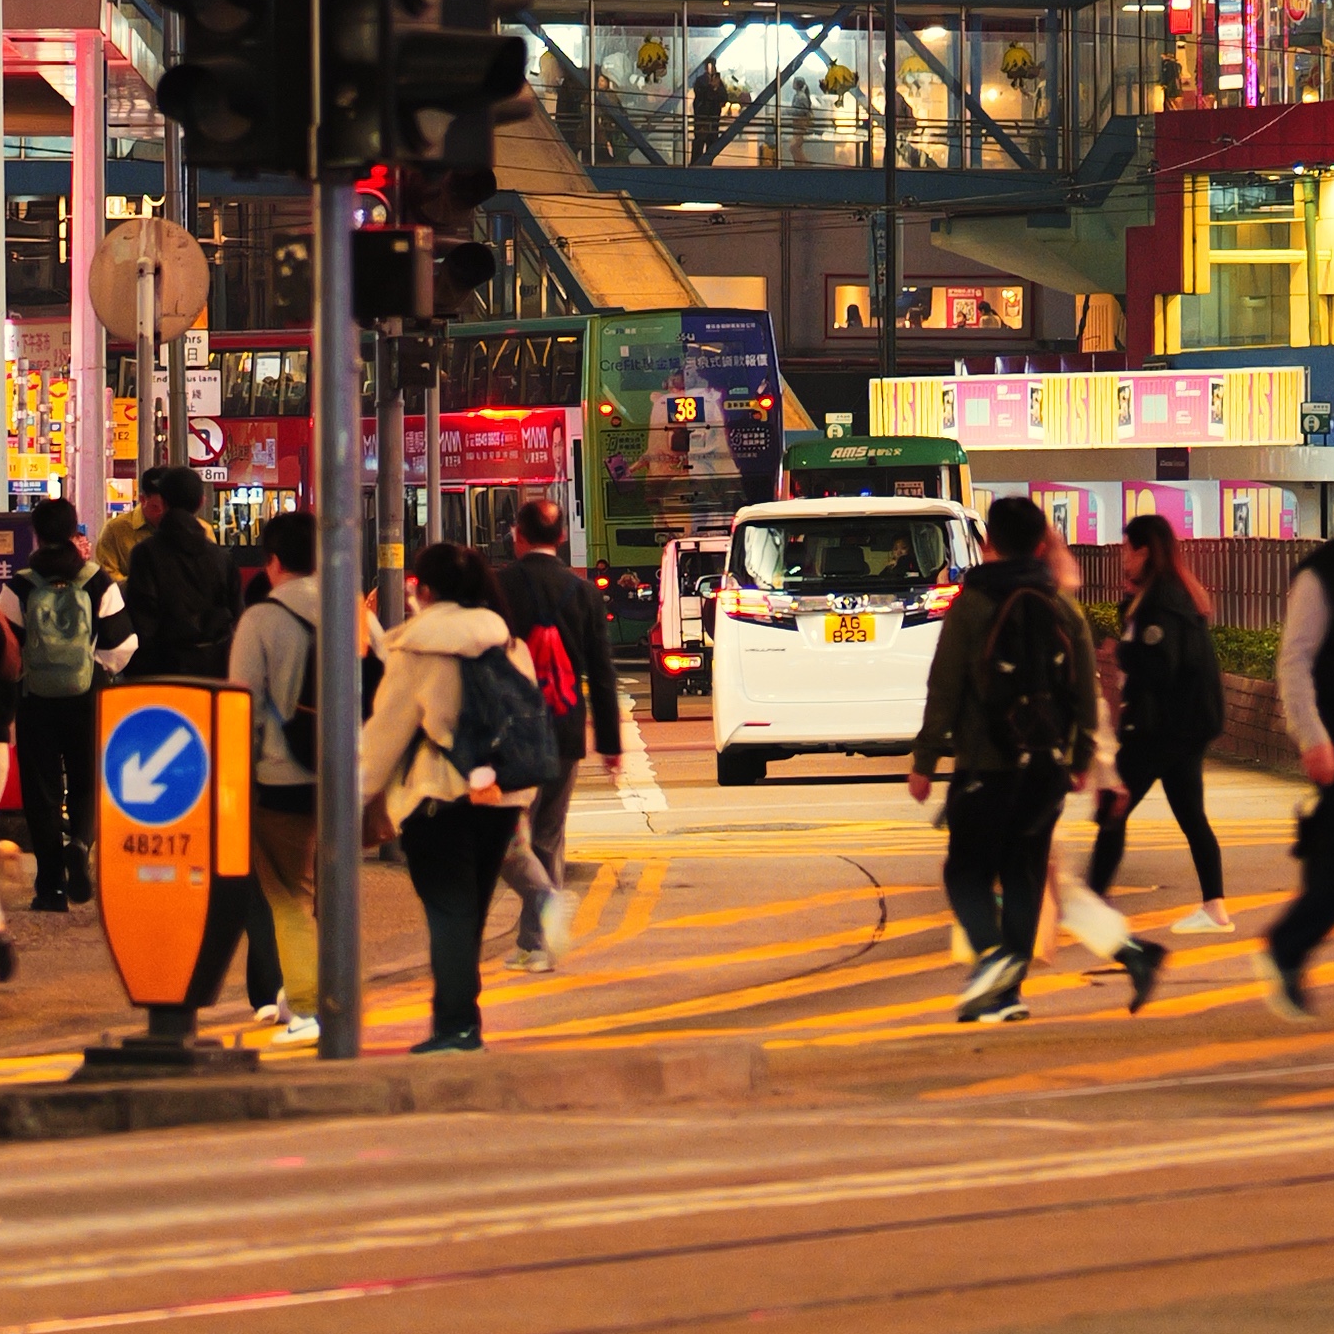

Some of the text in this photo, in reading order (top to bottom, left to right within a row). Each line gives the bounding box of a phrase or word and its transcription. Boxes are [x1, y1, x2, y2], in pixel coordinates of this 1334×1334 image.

[198, 374, 218, 384] lane
[673, 396, 698, 422] 38
[831, 446, 869, 458] AMS
[840, 616, 861, 630] AG
[833, 630, 867, 643] 823
[122, 833, 192, 857] 48217
